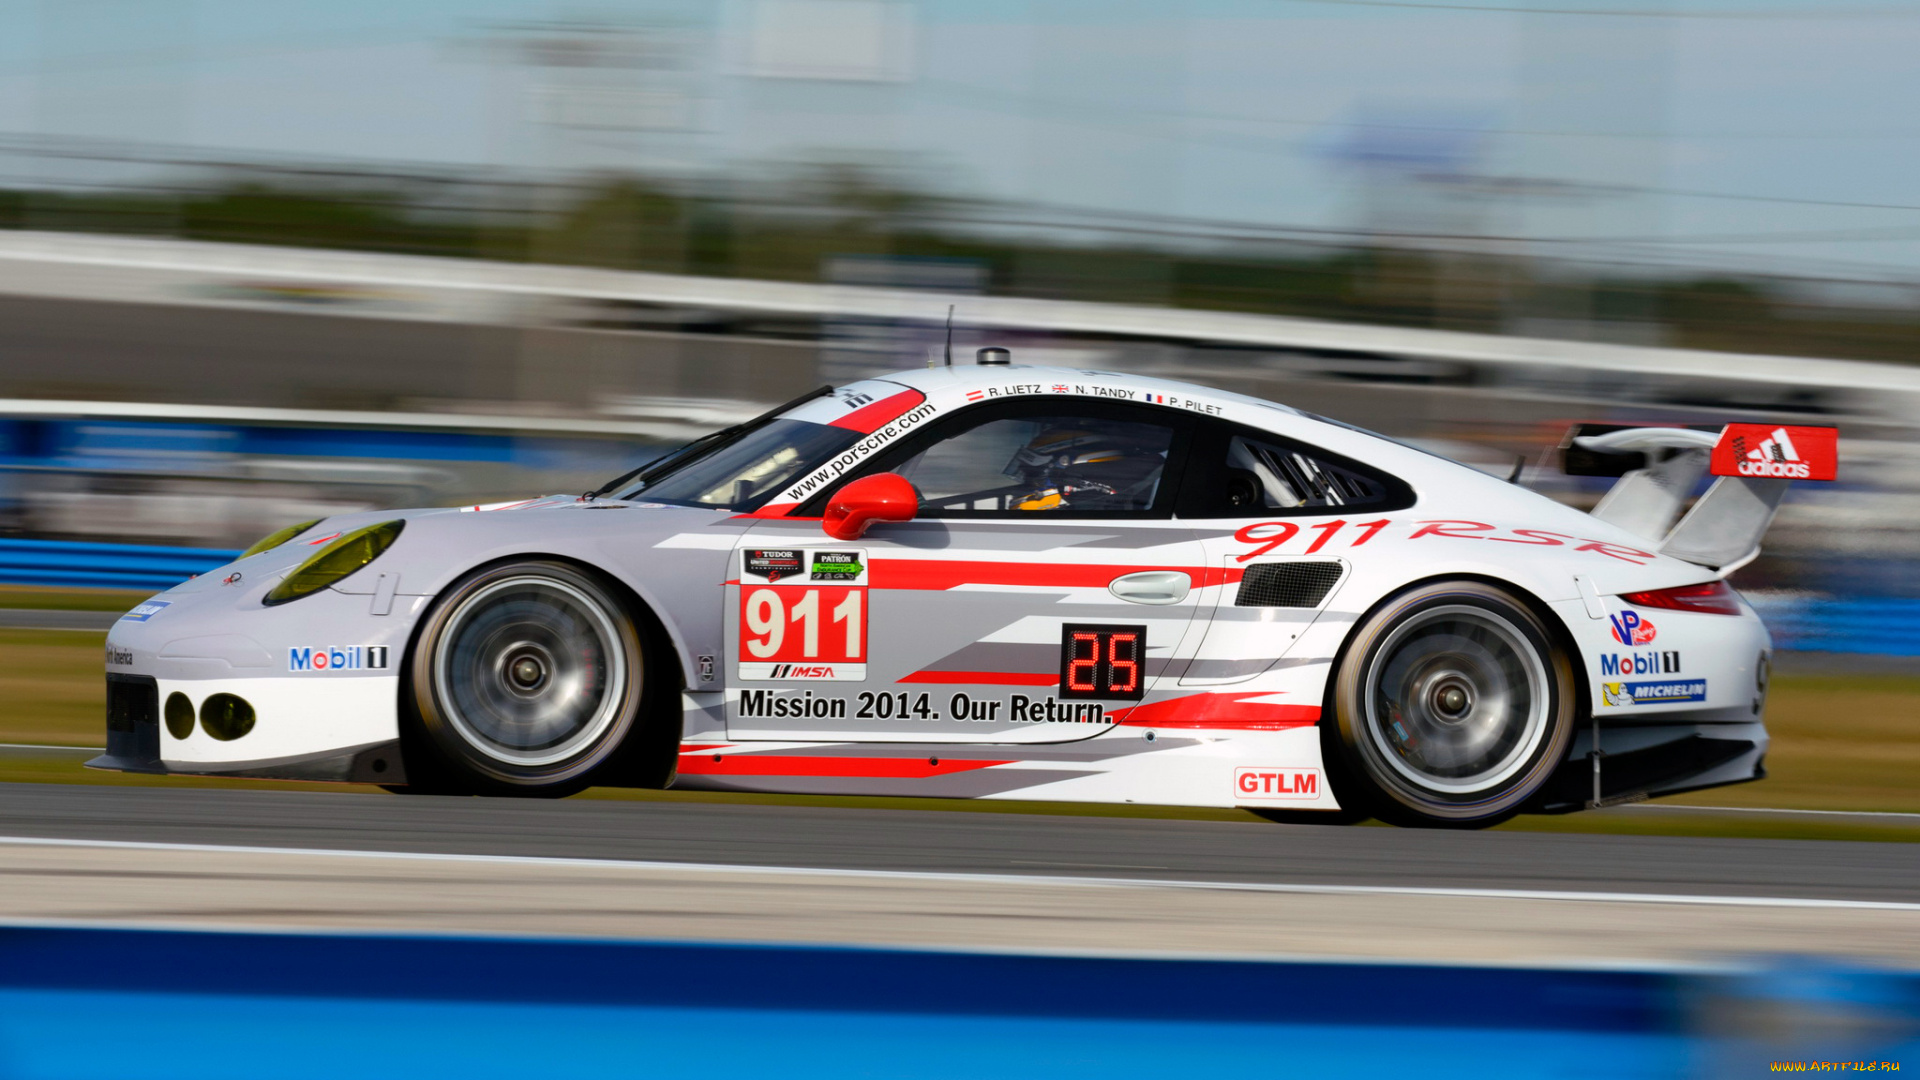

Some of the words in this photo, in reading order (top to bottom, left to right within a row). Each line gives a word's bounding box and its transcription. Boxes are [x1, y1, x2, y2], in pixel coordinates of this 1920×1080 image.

[989, 387, 1002, 397] R.
[1005, 384, 1042, 395] LIETZ
[1075, 385, 1088, 395] N.
[1092, 386, 1136, 399] TANDY
[1169, 397, 1182, 408] P.
[1185, 400, 1223, 416] PILET
[1738, 459, 1811, 478] adidas
[1234, 518, 1392, 564] 911
[1408, 519, 1658, 566] RSR
[745, 588, 862, 658] 911
[1609, 610, 1640, 646] VP
[290, 646, 361, 670] Mobil
[369, 647, 385, 668] 1
[1068, 632, 1137, 692] 25
[1600, 652, 1659, 676] Mobil
[1665, 652, 1678, 673] 1
[790, 666, 835, 678] IMSA
[1634, 683, 1706, 698] MICHELIN
[738, 690, 846, 719] Mission
[856, 692, 939, 720] 2014.
[950, 693, 1001, 721] Our
[1010, 696, 1113, 724] Return.
[1238, 772, 1317, 794] GTLM
